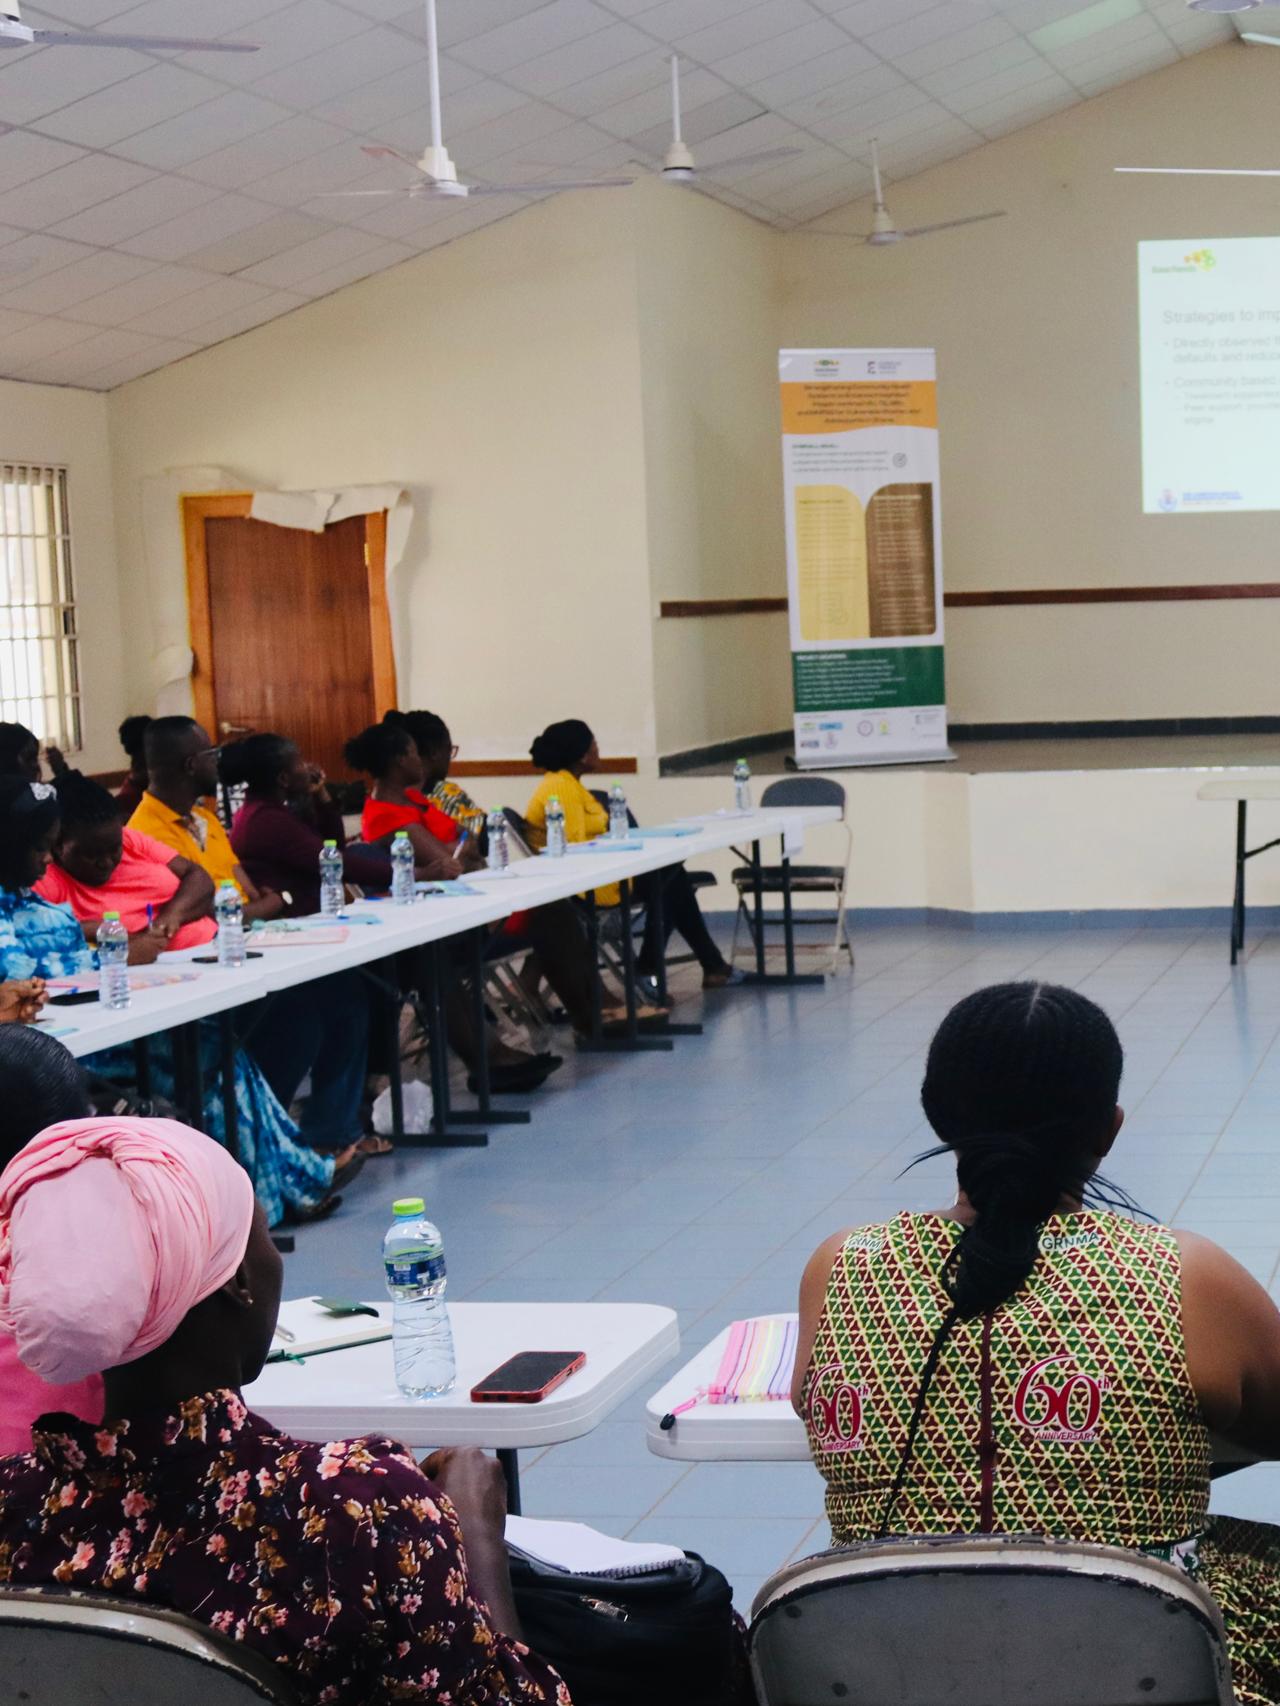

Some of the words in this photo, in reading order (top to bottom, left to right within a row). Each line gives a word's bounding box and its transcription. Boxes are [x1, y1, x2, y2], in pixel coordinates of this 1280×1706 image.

[1162, 308, 1235, 325] Strategies
[1239, 308, 1255, 322] to
[1041, 1232, 1099, 1250] GRNMA
[1034, 1431, 1096, 1441] ANNIVERSARY
